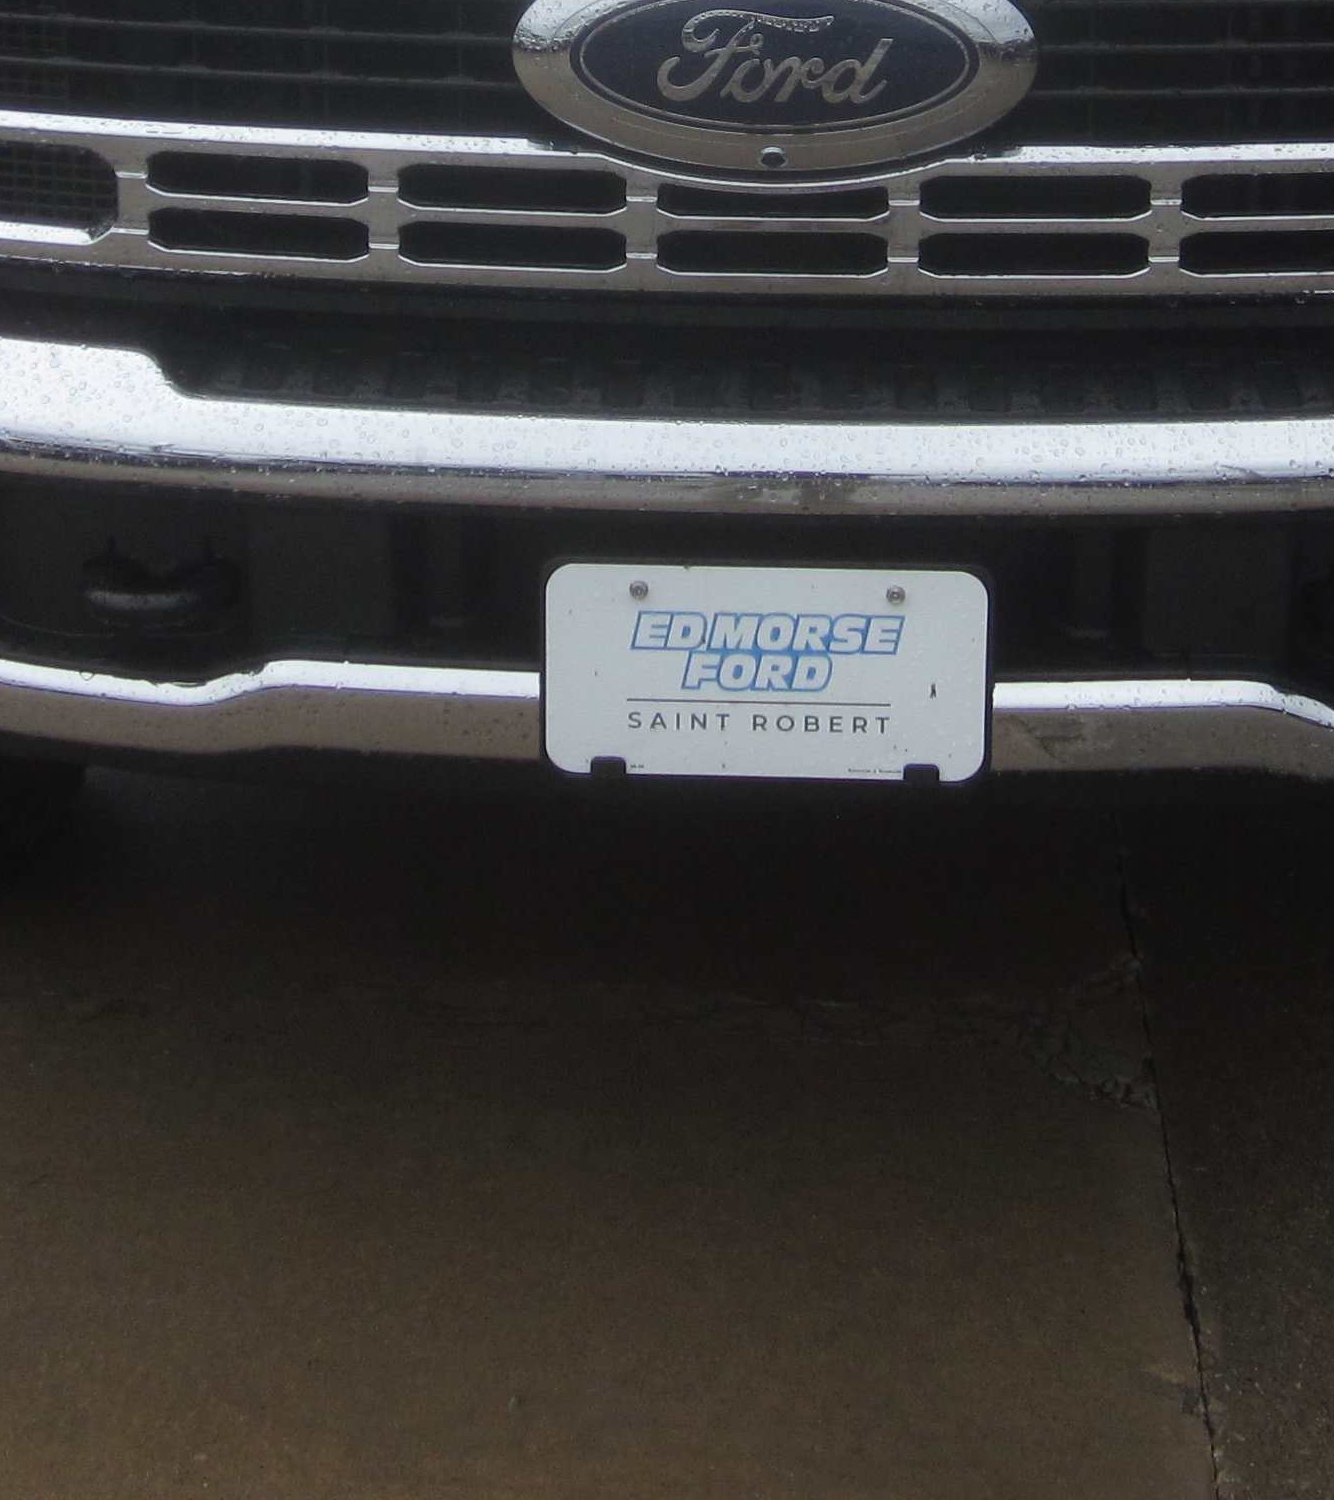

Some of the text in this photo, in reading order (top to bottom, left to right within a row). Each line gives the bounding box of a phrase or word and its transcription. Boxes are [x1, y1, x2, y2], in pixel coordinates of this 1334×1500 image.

[656, 8, 894, 104] Ford
[631, 611, 905, 655] ED MORSE
[681, 650, 833, 692] FORD
[627, 711, 891, 735] SAINT ROBERT
